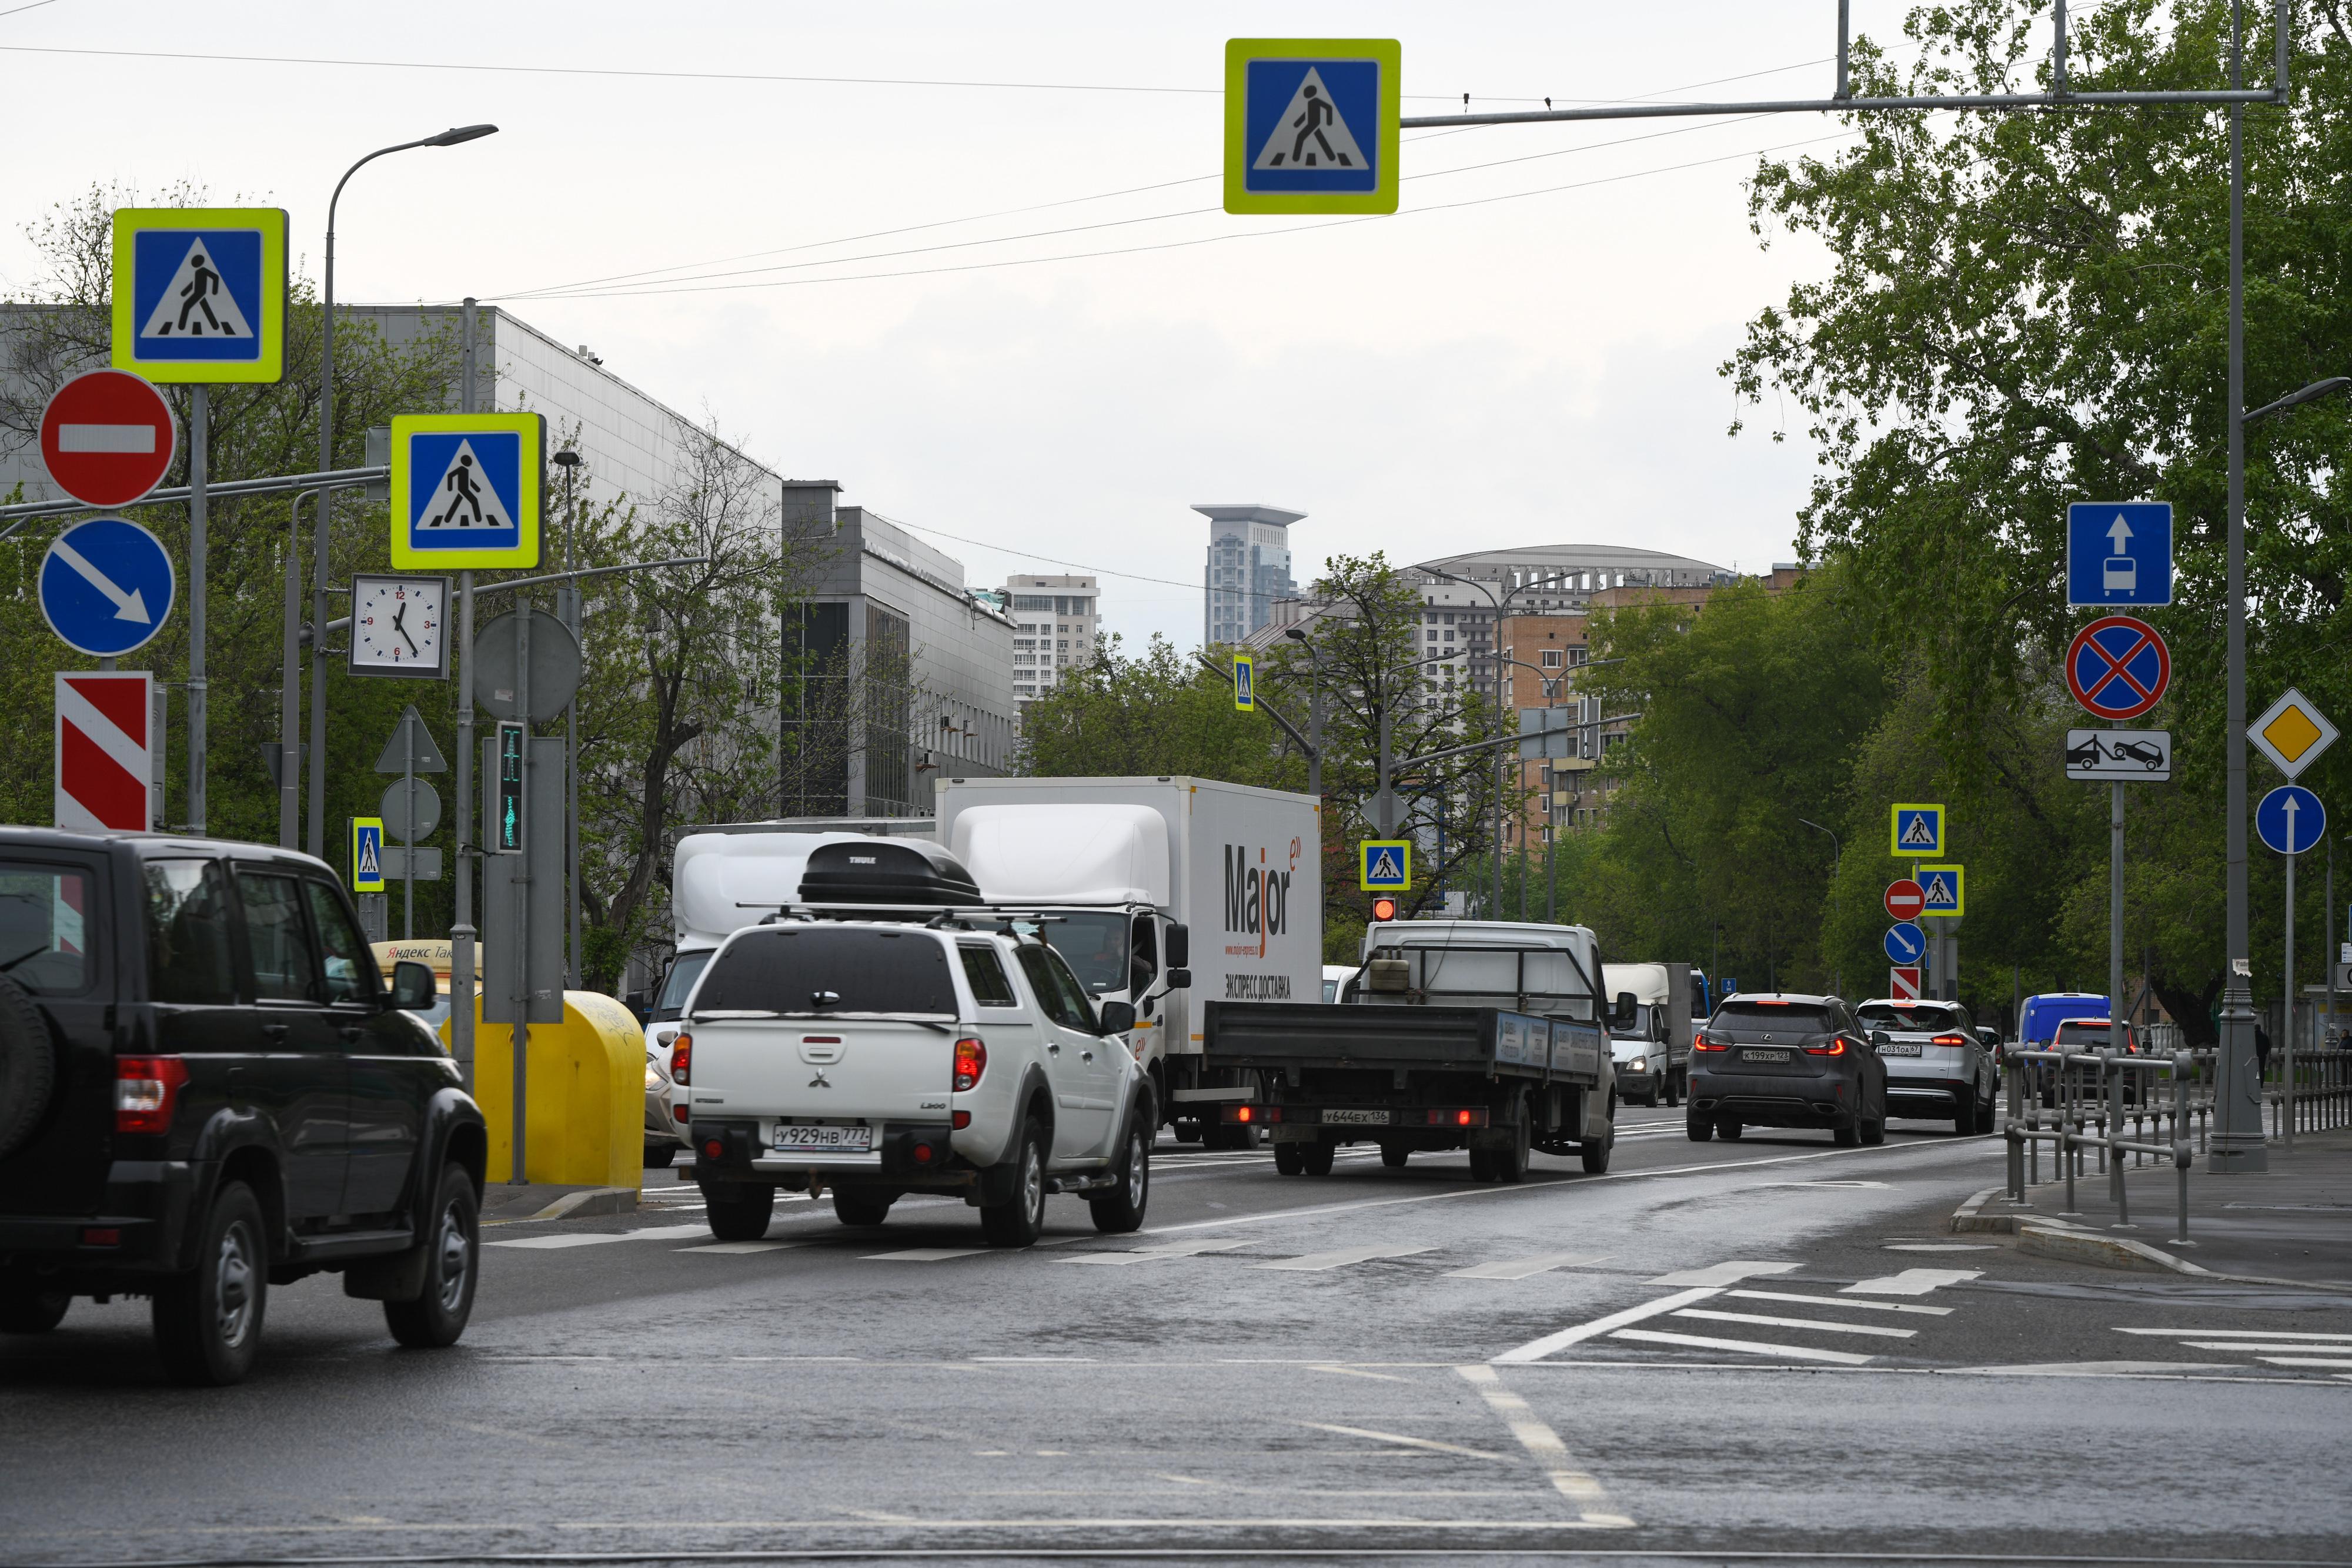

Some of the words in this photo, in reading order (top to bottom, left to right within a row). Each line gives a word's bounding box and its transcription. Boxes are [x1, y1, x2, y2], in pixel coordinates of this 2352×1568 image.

[395, 591, 405, 600] 12
[367, 617, 373, 625] 9
[424, 621, 430, 629] 3
[394, 647, 400, 656] 6
[849, 856, 877, 864] THULE
[1225, 844, 1290, 959] Major
[386, 947, 431, 959] Яндекс
[435, 946, 452, 958] Так
[1225, 942, 1258, 958] www.major-express.ru
[1225, 973, 1258, 999] ЭКСПРЕСС
[1258, 975, 1291, 1002] ДОСТАВКА
[1745, 1051, 1775, 1059] К199ХР
[1326, 1111, 1368, 1123] У644ЕХ
[1370, 1111, 1387, 1120] 136
[780, 1128, 840, 1144] У929НВ
[843, 1128, 867, 1140] 777
